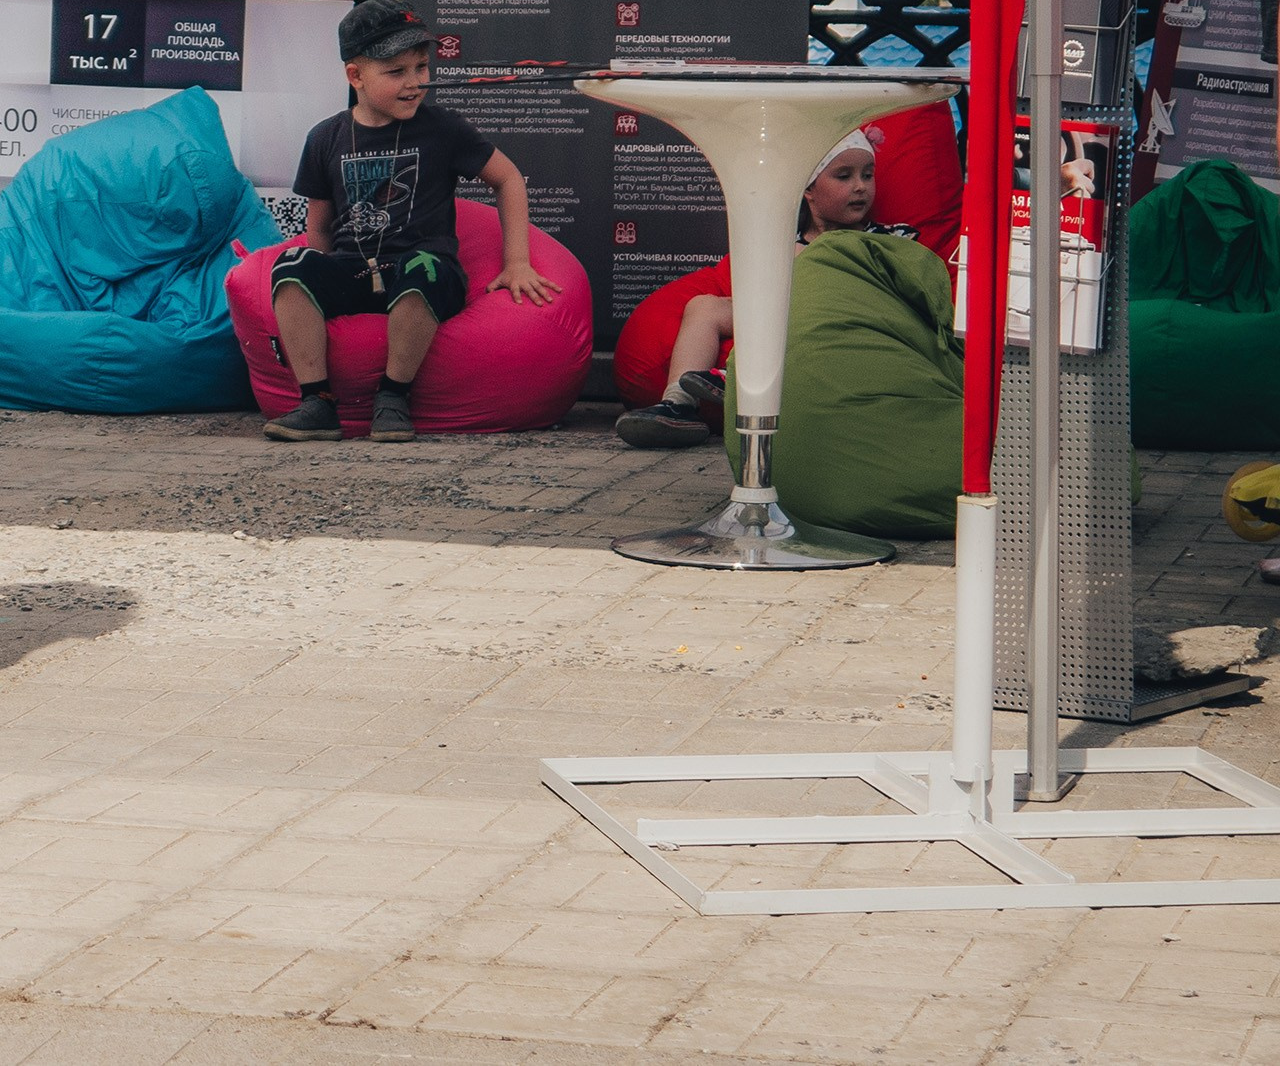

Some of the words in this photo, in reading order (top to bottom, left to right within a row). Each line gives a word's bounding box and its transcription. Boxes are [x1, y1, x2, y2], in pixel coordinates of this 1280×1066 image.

[437, 17, 478, 25] продукции
[84, 14, 118, 40] 17
[174, 21, 216, 33] ОБЩАЯ
[168, 35, 225, 48] ПЛОЩАДЬ
[616, 35, 669, 43] ПЕРЕДОВЫЕ
[671, 35, 730, 43] ТЕХНОЛОГИИ
[151, 49, 240, 62] ПРОИЗВОДСТВА
[1197, 73, 1269, 94] Радиоастрономия
[467, 97, 506, 105] устройств
[614, 144, 664, 152] КАДРОВЫЙ
[614, 164, 667, 172] собственного
[613, 253, 672, 261] УСТОЙЧИВАЯ
[613, 264, 669, 272] Долгосрочные
